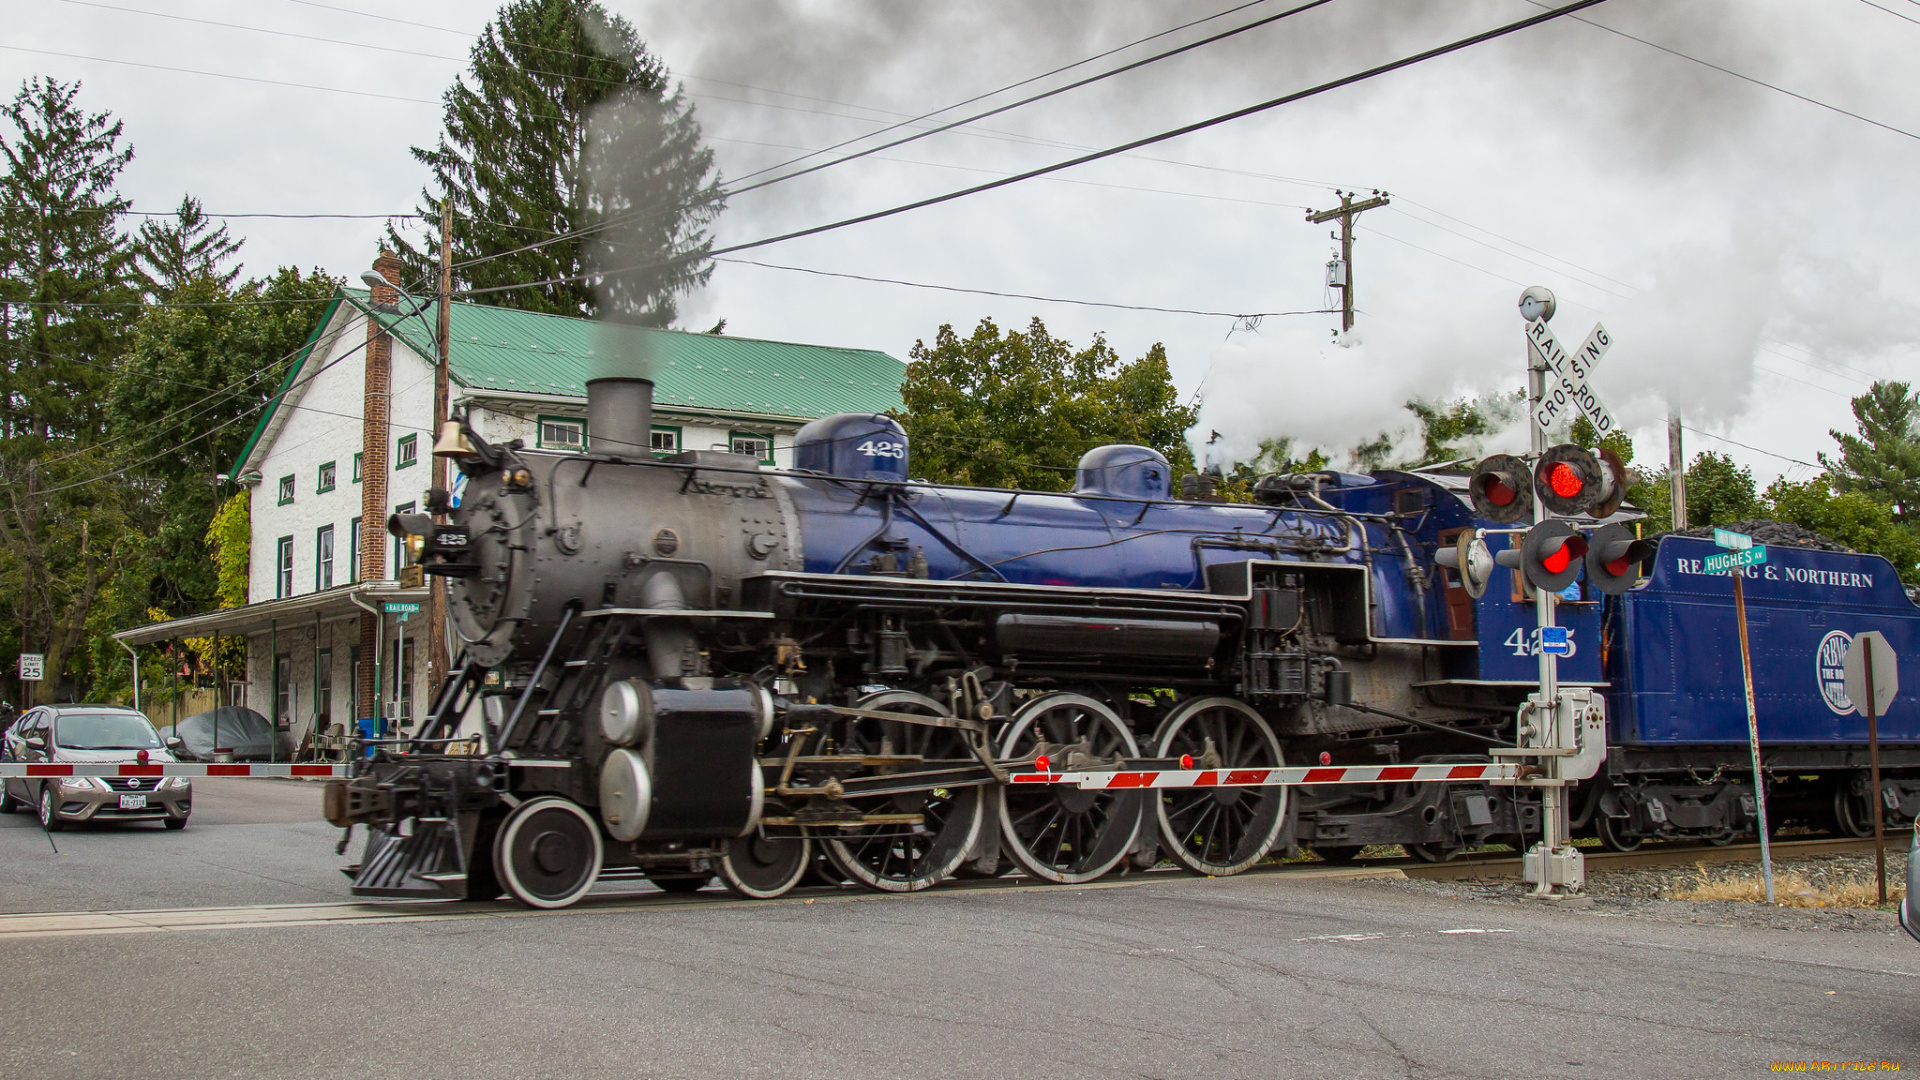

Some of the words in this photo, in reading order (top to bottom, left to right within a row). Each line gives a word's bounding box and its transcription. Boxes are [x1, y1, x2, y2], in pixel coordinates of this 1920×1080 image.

[1532, 322, 1565, 373] RAIL
[1576, 384, 1609, 431] ROAD
[1538, 330, 1609, 427] CROSSING
[856, 441, 904, 459] 425
[437, 534, 467, 545] 425
[1707, 550, 1752, 571] HUGHES
[1754, 551, 1763, 560] AV
[1677, 558, 1759, 579] REIG
[1764, 565, 1780, 580] &
[1785, 567, 1873, 588] NORTHERN
[389, 604, 415, 612] RAILROAD
[22, 667, 41, 678] 25
